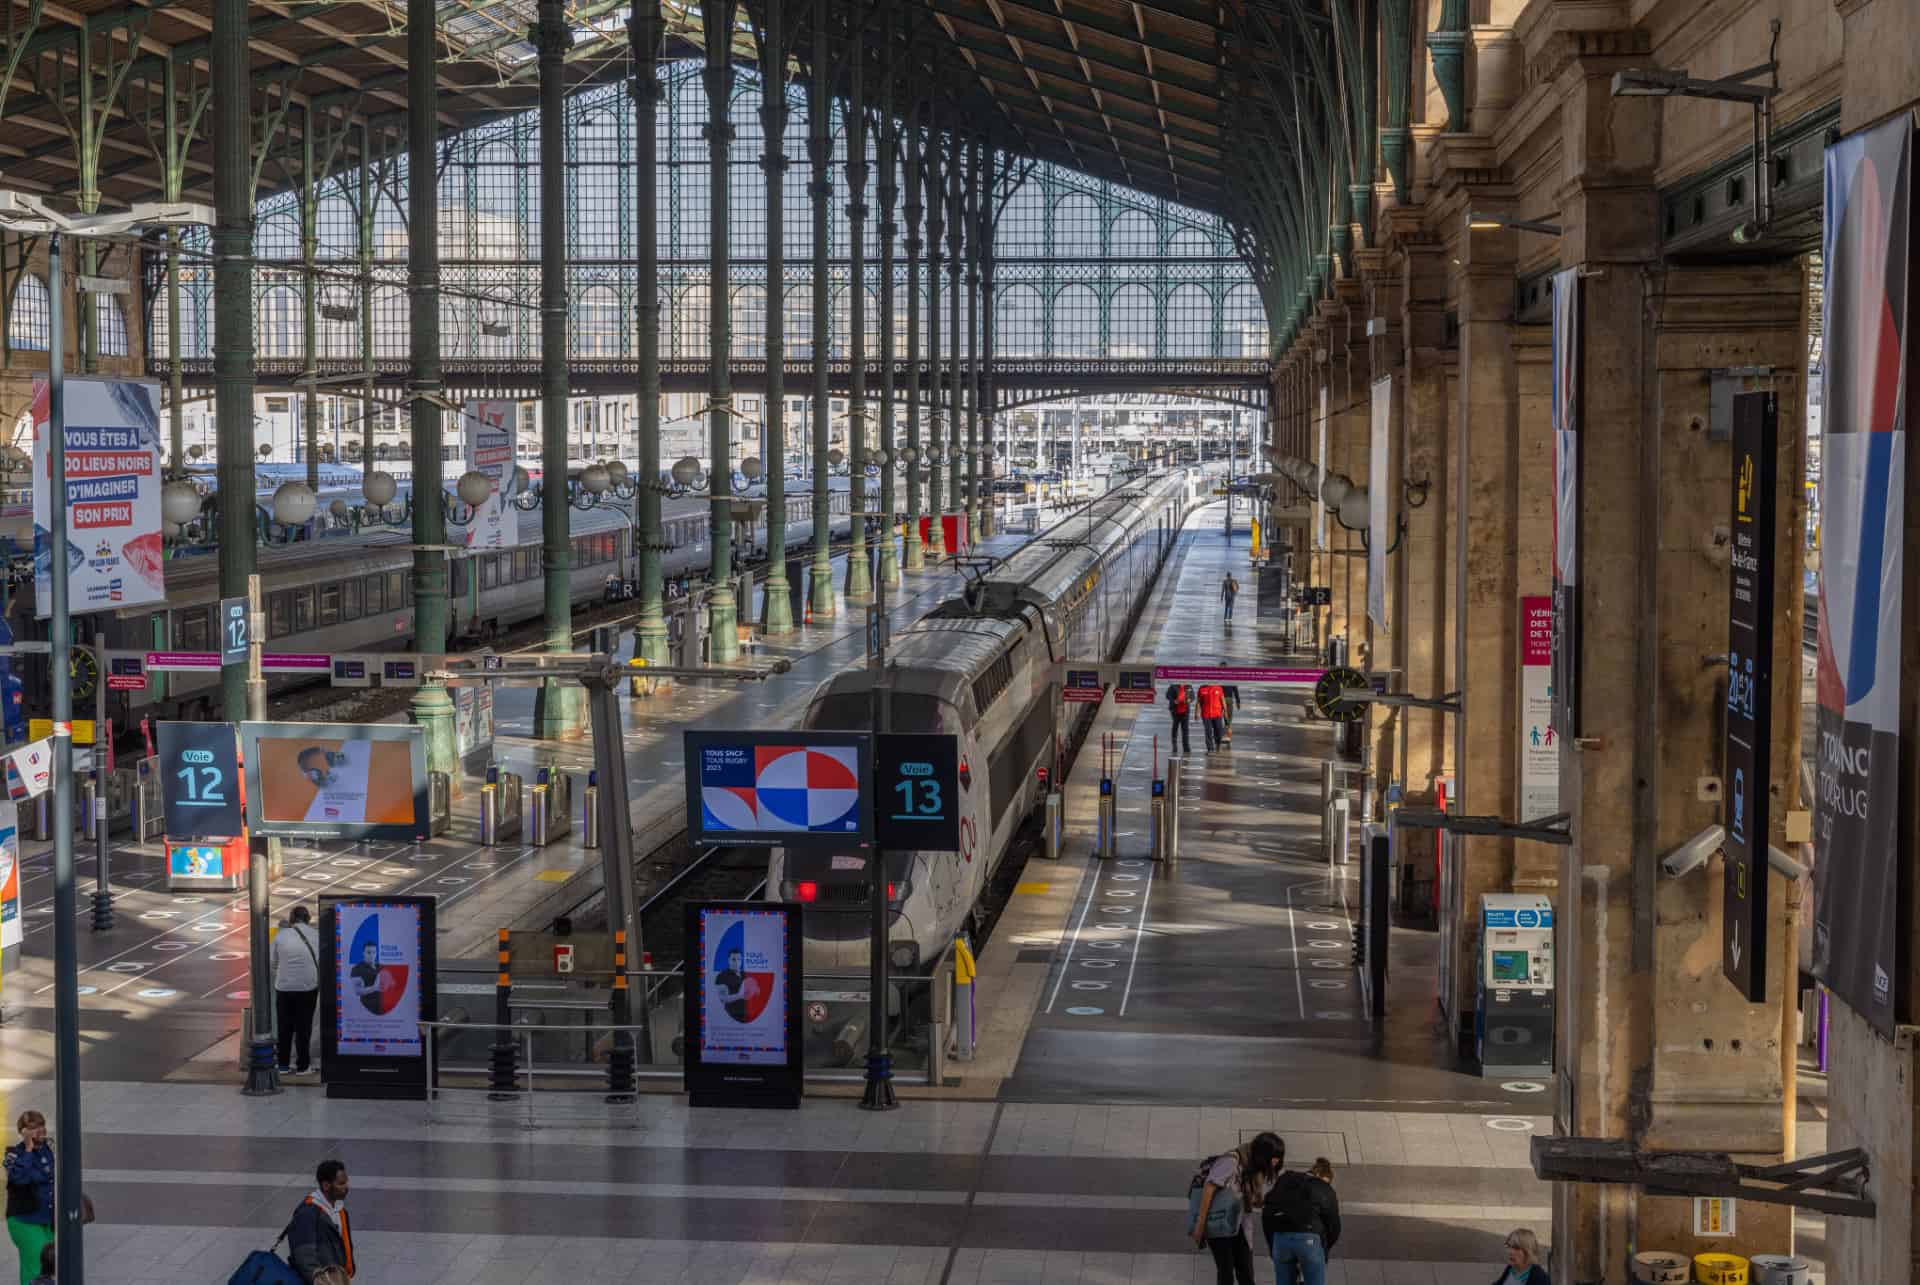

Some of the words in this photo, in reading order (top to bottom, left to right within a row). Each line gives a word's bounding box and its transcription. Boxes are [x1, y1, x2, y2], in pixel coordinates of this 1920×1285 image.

[64, 431, 98, 447] VOUS
[100, 428, 128, 446] ÊTES
[130, 429, 138, 446] À
[83, 456, 116, 472] LIEUS
[117, 455, 151, 471] NOIRS
[68, 479, 137, 500] D'IMAGINER
[76, 508, 101, 523] SON
[103, 507, 130, 521] PRIX
[228, 619, 246, 648] 12
[184, 751, 210, 761] Voie
[904, 764, 929, 774] Voie
[176, 767, 224, 800] 12
[895, 780, 942, 813] 13
